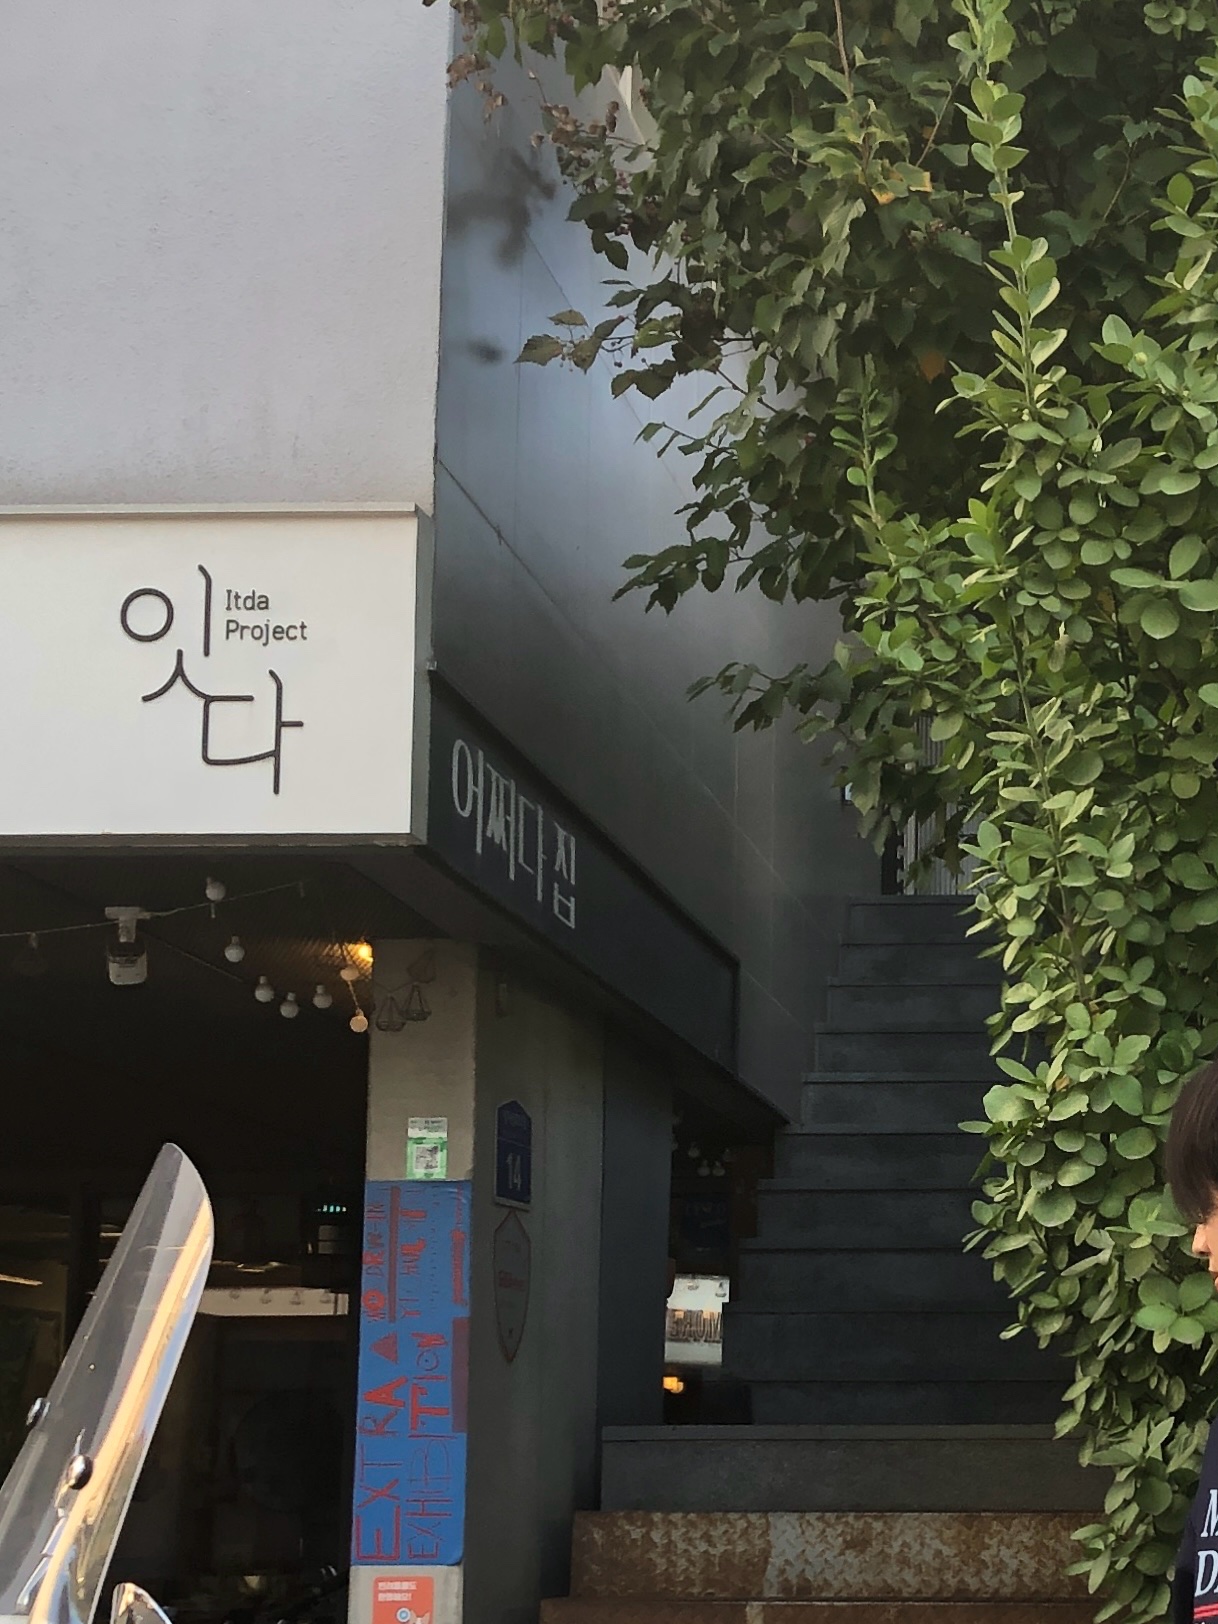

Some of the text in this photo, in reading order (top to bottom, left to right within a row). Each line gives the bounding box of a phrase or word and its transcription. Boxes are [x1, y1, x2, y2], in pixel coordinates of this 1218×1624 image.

[225, 589, 270, 611] Itda
[225, 619, 308, 647] Project
[452, 739, 576, 930] 어쩌다집
[506, 1152, 522, 1192] 14
[356, 1375, 408, 1561] EXTRA
[405, 1332, 457, 1560] EXHIBITION
